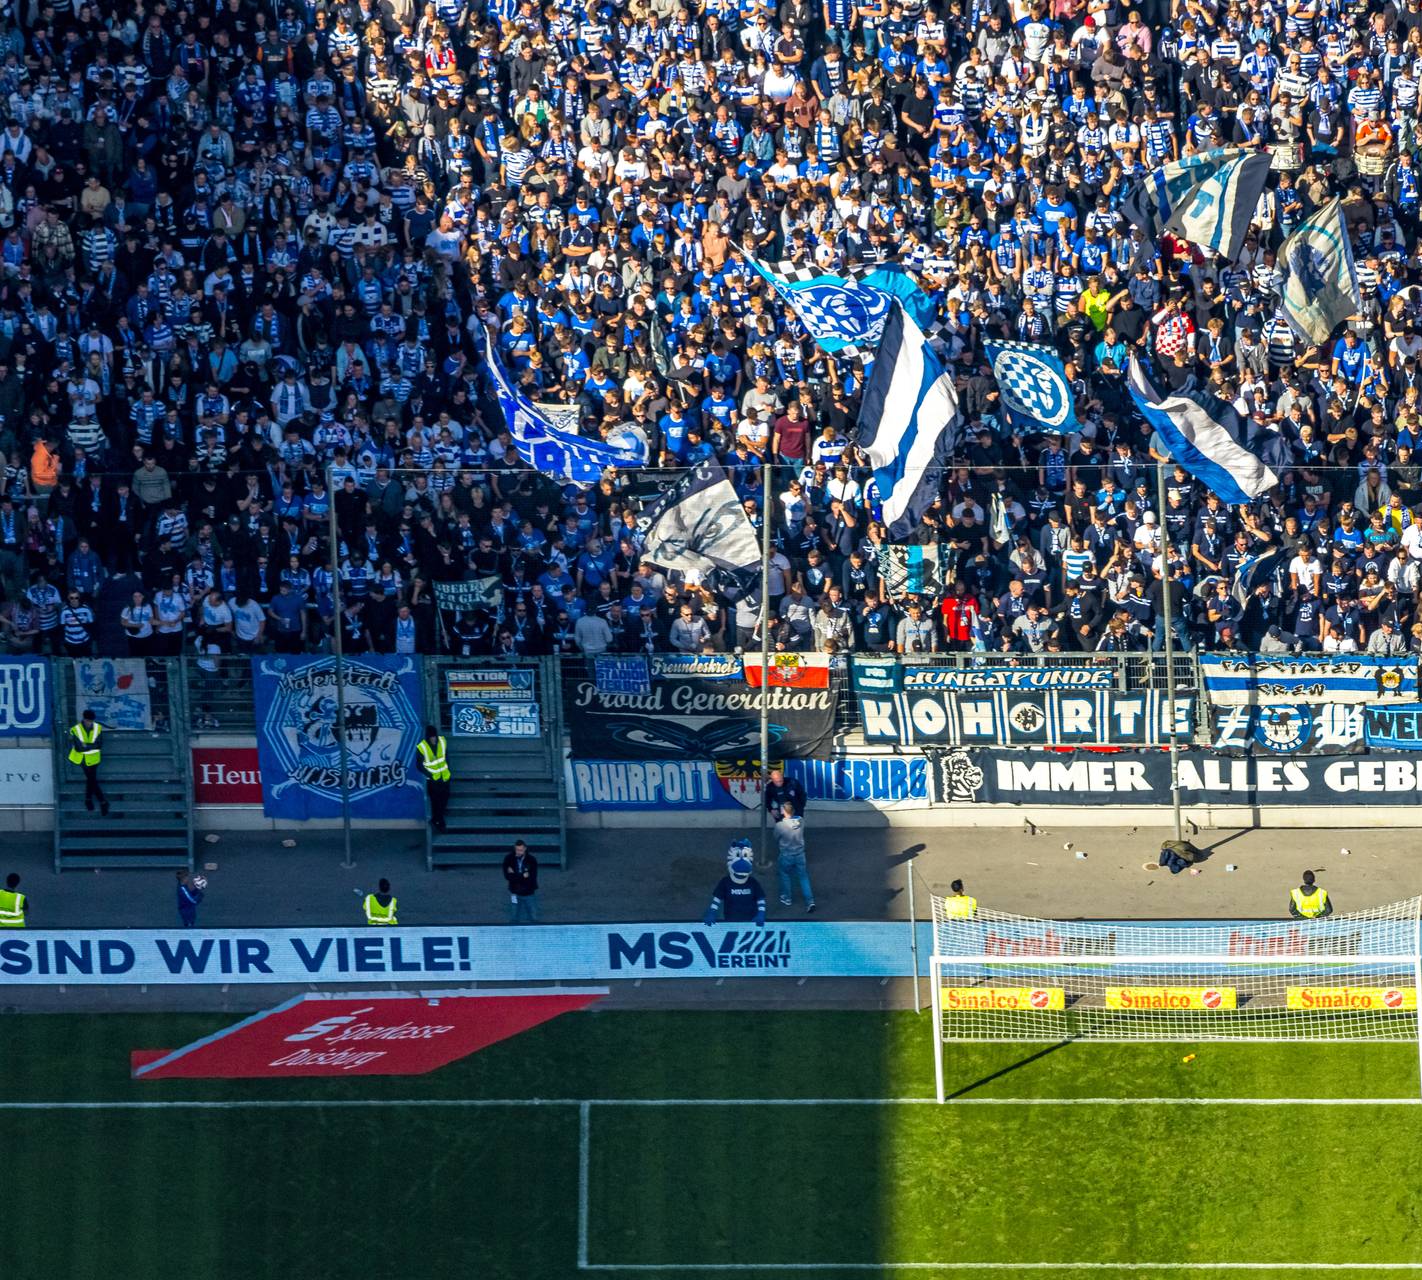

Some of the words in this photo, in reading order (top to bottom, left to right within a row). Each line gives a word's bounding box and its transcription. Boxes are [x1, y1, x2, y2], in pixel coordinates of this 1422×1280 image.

[448, 672, 508, 681] SEKTION
[576, 682, 665, 710] Proud
[671, 685, 831, 714] Generation
[498, 718, 536, 734] SÜD
[3, 772, 41, 782] rve
[574, 760, 714, 803] RUHRPOTT
[996, 759, 1153, 792] IMMER
[1170, 760, 1310, 792] ALLES
[0, 939, 135, 975] SIND
[155, 939, 274, 974] WIR
[289, 937, 472, 973] VIELE!
[947, 989, 1019, 1009] Sinalco
[1120, 988, 1191, 1009] Sinalco
[1301, 986, 1372, 1008] Sinalco
